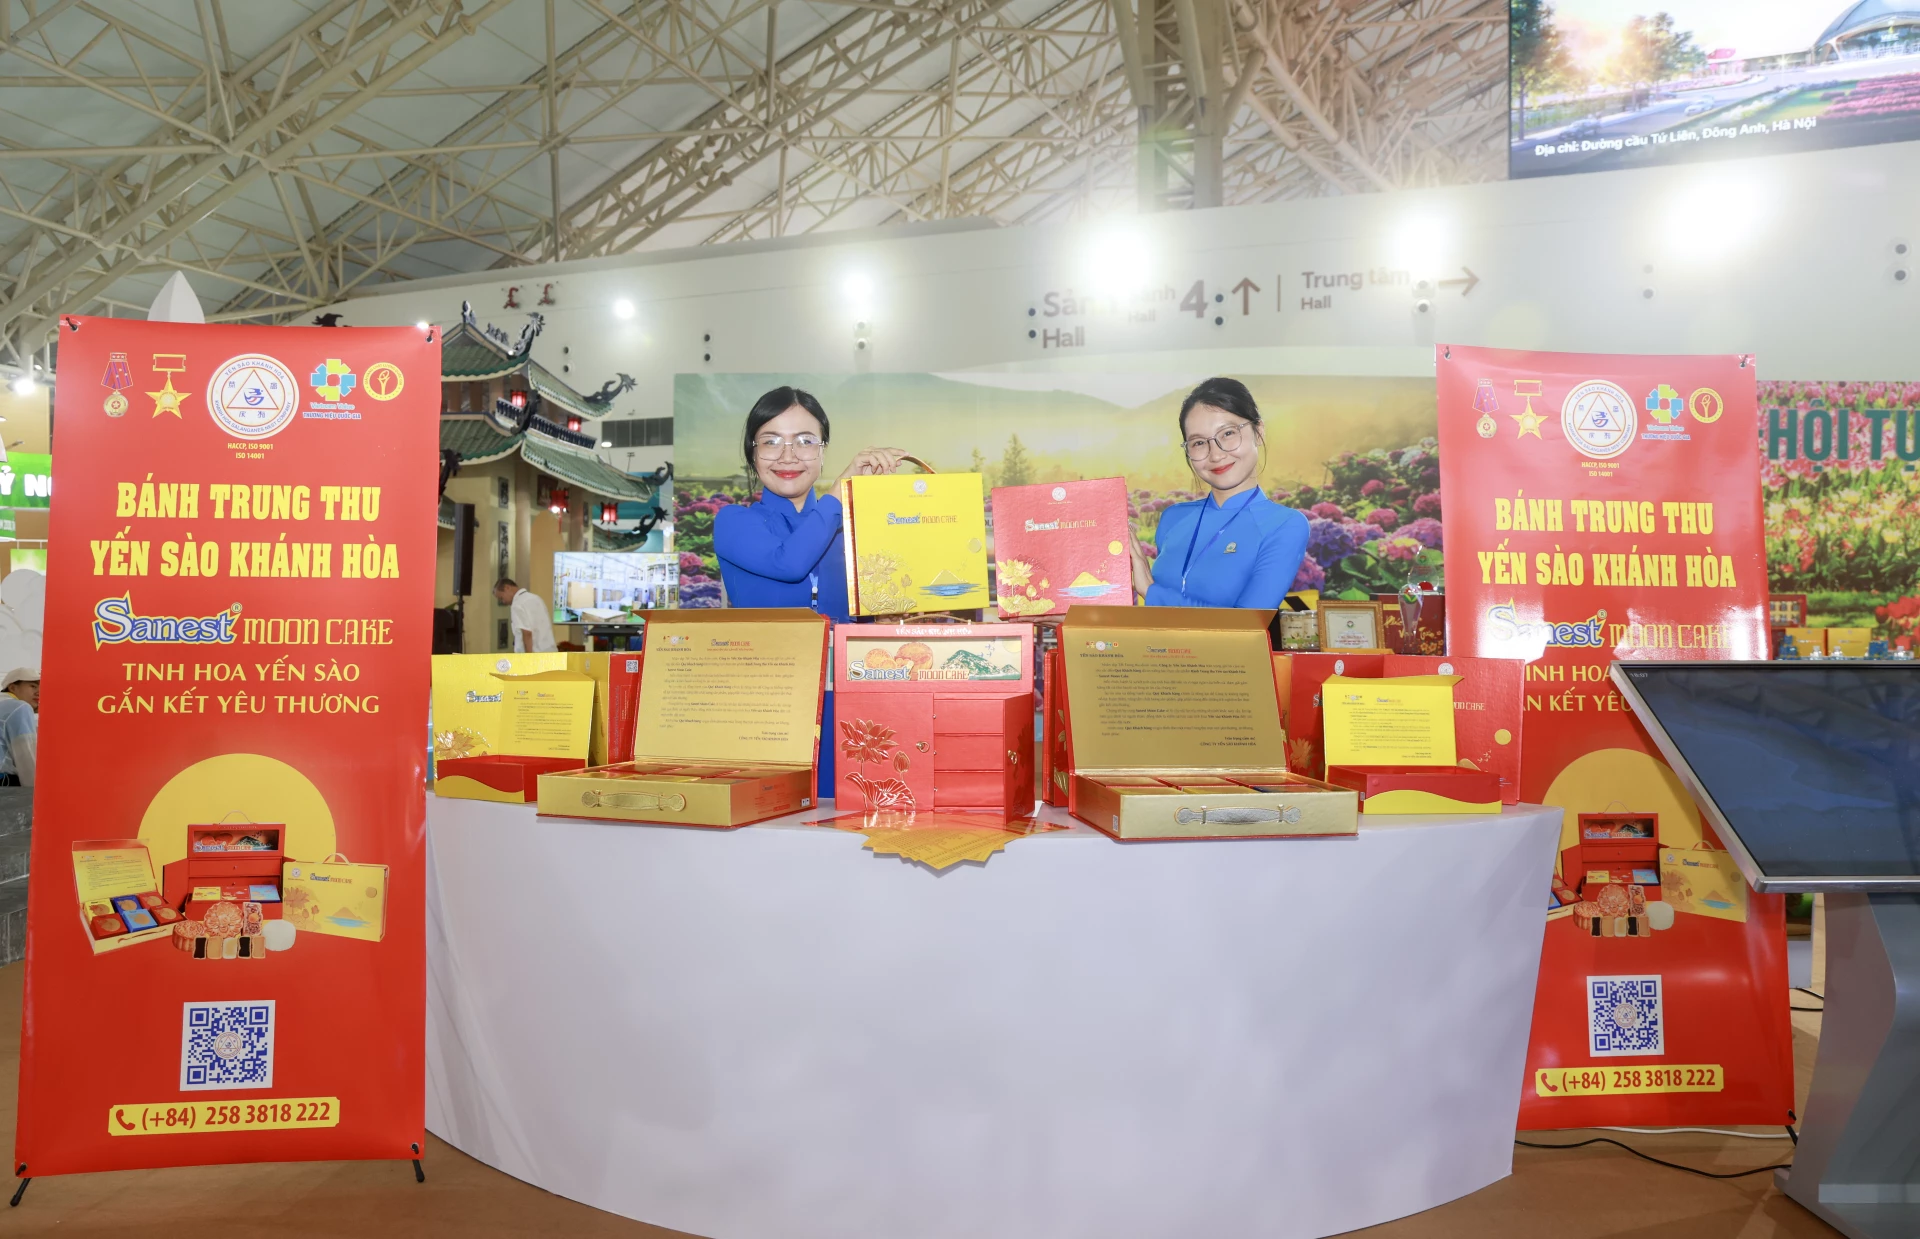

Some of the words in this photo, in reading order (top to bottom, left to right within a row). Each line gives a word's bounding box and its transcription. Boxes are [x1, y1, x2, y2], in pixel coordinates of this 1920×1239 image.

[1535, 144, 1556, 157] Địa
[1557, 141, 1580, 154] chỉ:
[1580, 138, 1623, 150] Đường
[1625, 135, 1648, 147] cầu
[1669, 130, 1700, 143] Liên,
[1702, 126, 1737, 139] Đông
[1739, 122, 1770, 135] Anh,
[1772, 119, 1791, 132] Hà
[1794, 116, 1817, 130] Nội
[1301, 270, 1364, 291] Trung
[1368, 266, 1411, 285] tâm
[1042, 288, 1116, 318] Sả
[1180, 279, 1208, 319] 4
[1300, 294, 1332, 311] Hall
[1042, 325, 1086, 349] Hall
[227, 443, 248, 451] HACCP,
[116, 473, 199, 519] BÁNH
[210, 484, 310, 521] TRUNG
[320, 486, 381, 522] THU
[1494, 490, 1563, 532] BÁNH
[1571, 500, 1656, 534] TRUNG
[1662, 502, 1714, 535] THU
[90, 526, 150, 577] YẾN
[160, 532, 219, 578] SÀO
[230, 532, 332, 579] KHÁNH
[341, 534, 400, 579] HÒA
[1477, 538, 1527, 585] YẾN
[1535, 545, 1584, 586] SÀO
[1592, 545, 1678, 588] KHÁNH
[1685, 546, 1737, 588] HÒA
[243, 618, 319, 645] MOON
[325, 619, 394, 645] CAKE
[1609, 623, 1673, 648] MOON
[122, 662, 185, 681] TINH
[194, 663, 247, 681] HOA
[255, 654, 304, 681] YẾN
[314, 657, 360, 682] SÀO
[919, 670, 944, 680] MOON
[945, 670, 969, 680] CAKE
[1525, 664, 1565, 682] INH
[97, 687, 157, 714] GẮN
[164, 686, 210, 714] KẾT
[218, 690, 266, 714] YÊU
[274, 694, 380, 714] THƯƠNG
[1465, 702, 1486, 711] CAKE
[1549, 686, 1587, 712] KẾT
[1562, 1070, 1606, 1092] (+84)
[1613, 1070, 1642, 1088] 258
[1645, 1069, 1682, 1087] 3818
[1686, 1068, 1716, 1086] 222
[142, 1106, 197, 1131] (+84)
[205, 1106, 241, 1126] 258
[245, 1103, 292, 1125] 3818
[295, 1101, 331, 1122] 222
